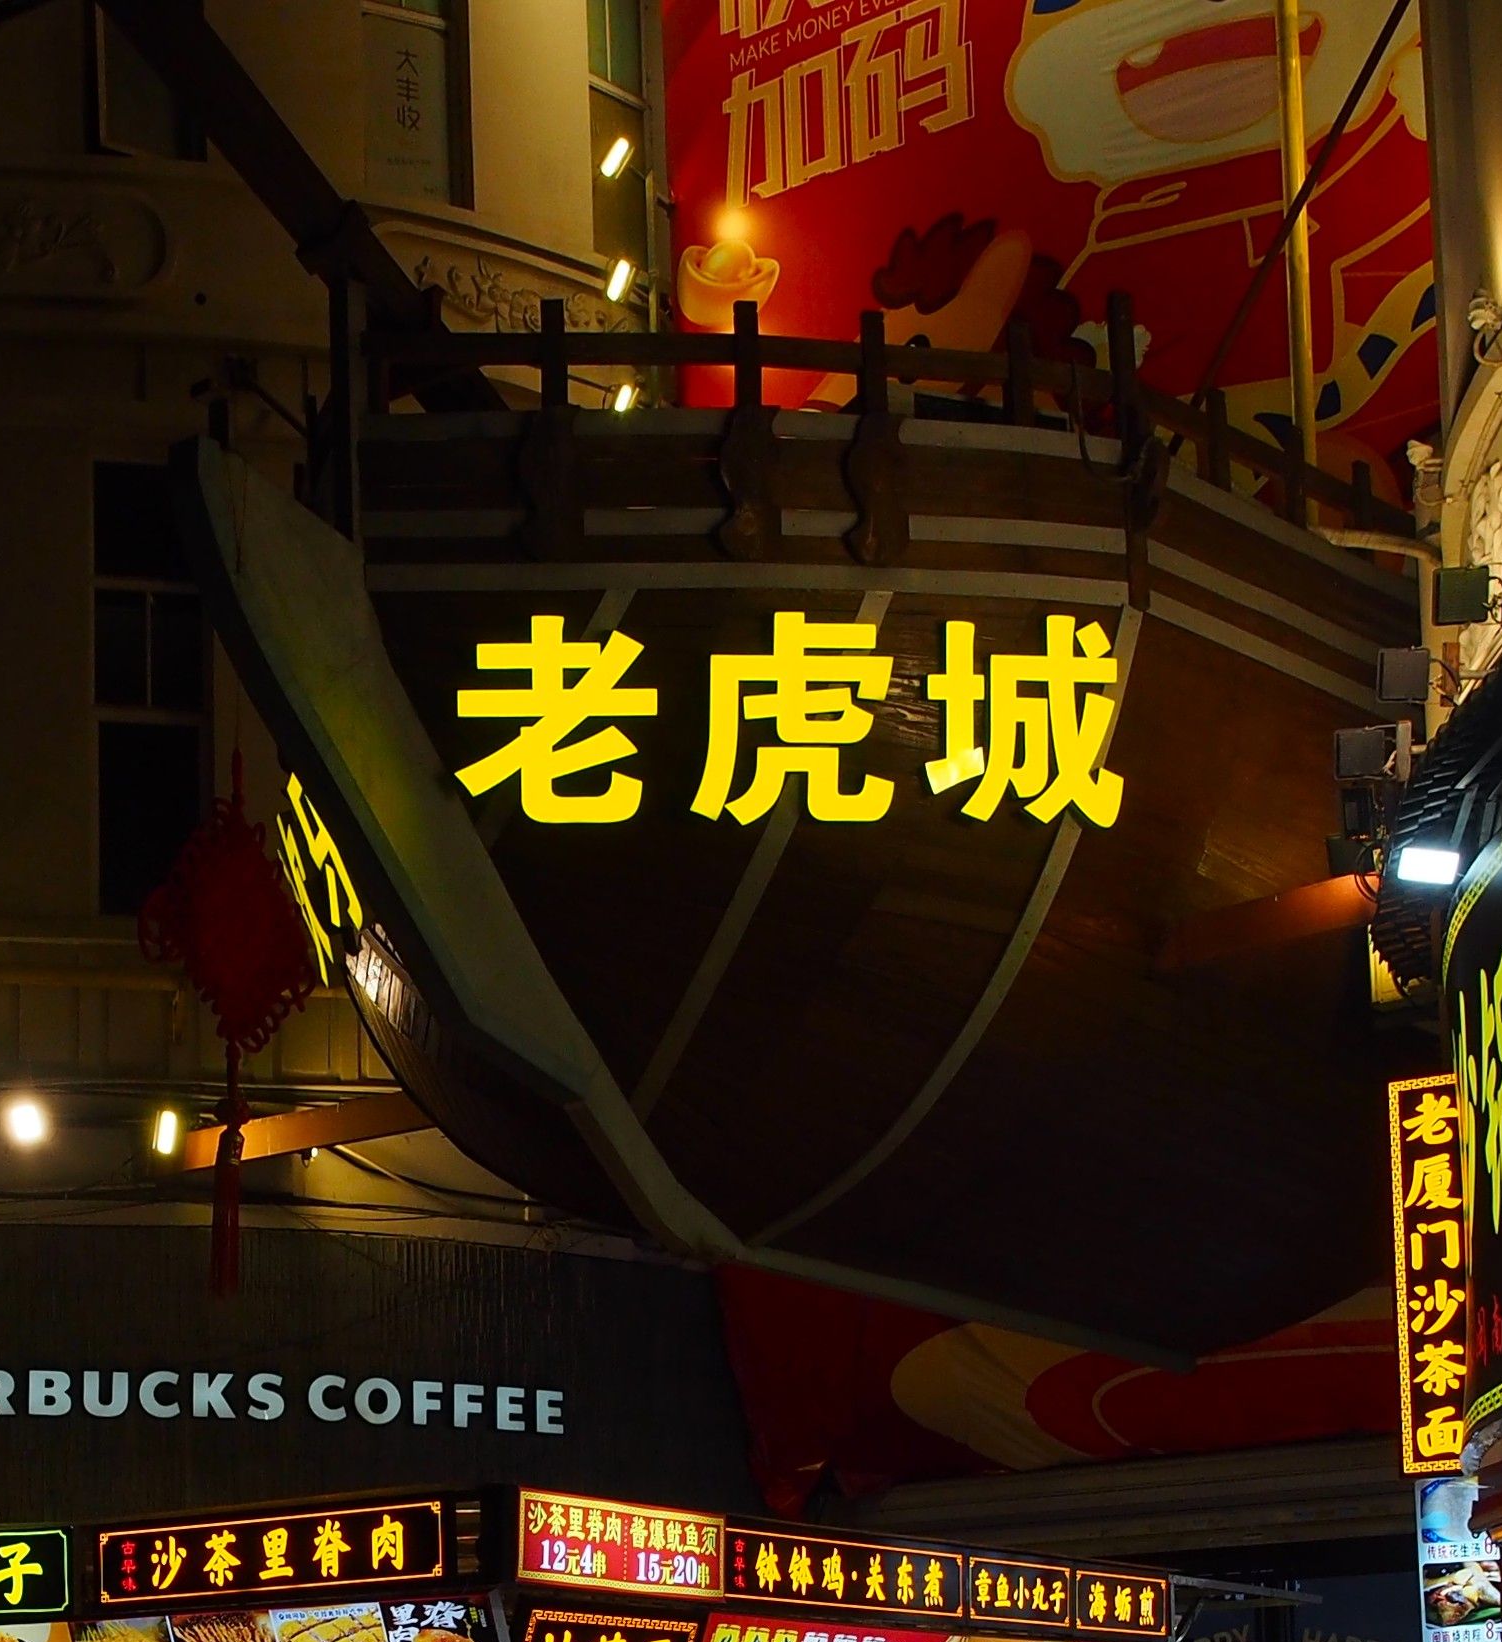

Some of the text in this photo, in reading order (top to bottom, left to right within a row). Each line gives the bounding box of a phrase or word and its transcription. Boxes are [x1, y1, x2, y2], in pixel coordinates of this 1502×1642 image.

[729, 1, 854, 72] MAKE MONEY
[395, 49, 421, 131] 大丰收
[721, 0, 975, 207] 加码
[454, 611, 1124, 828] 老虎城
[1403, 1093, 1467, 1457] 老厦门沙茶面
[308, 1374, 565, 1435] COFFEE
[151, 1515, 405, 1590] 沙茶里脊肉
[528, 1502, 717, 1555] 沙茶里脊肉 酱爆鱿鱼须
[1427, 1543, 1481, 1559] 传统花生汤
[121, 1541, 136, 1592] 古早味
[541, 1540, 709, 1587] 12元4串 15元20串
[734, 1539, 746, 1587] 古早味
[754, 1542, 944, 1607] 钵钵鸡·关东煮
[975, 1571, 1065, 1614] 章鱼小丸子
[1088, 1584, 1154, 1626] 海蛎煎
